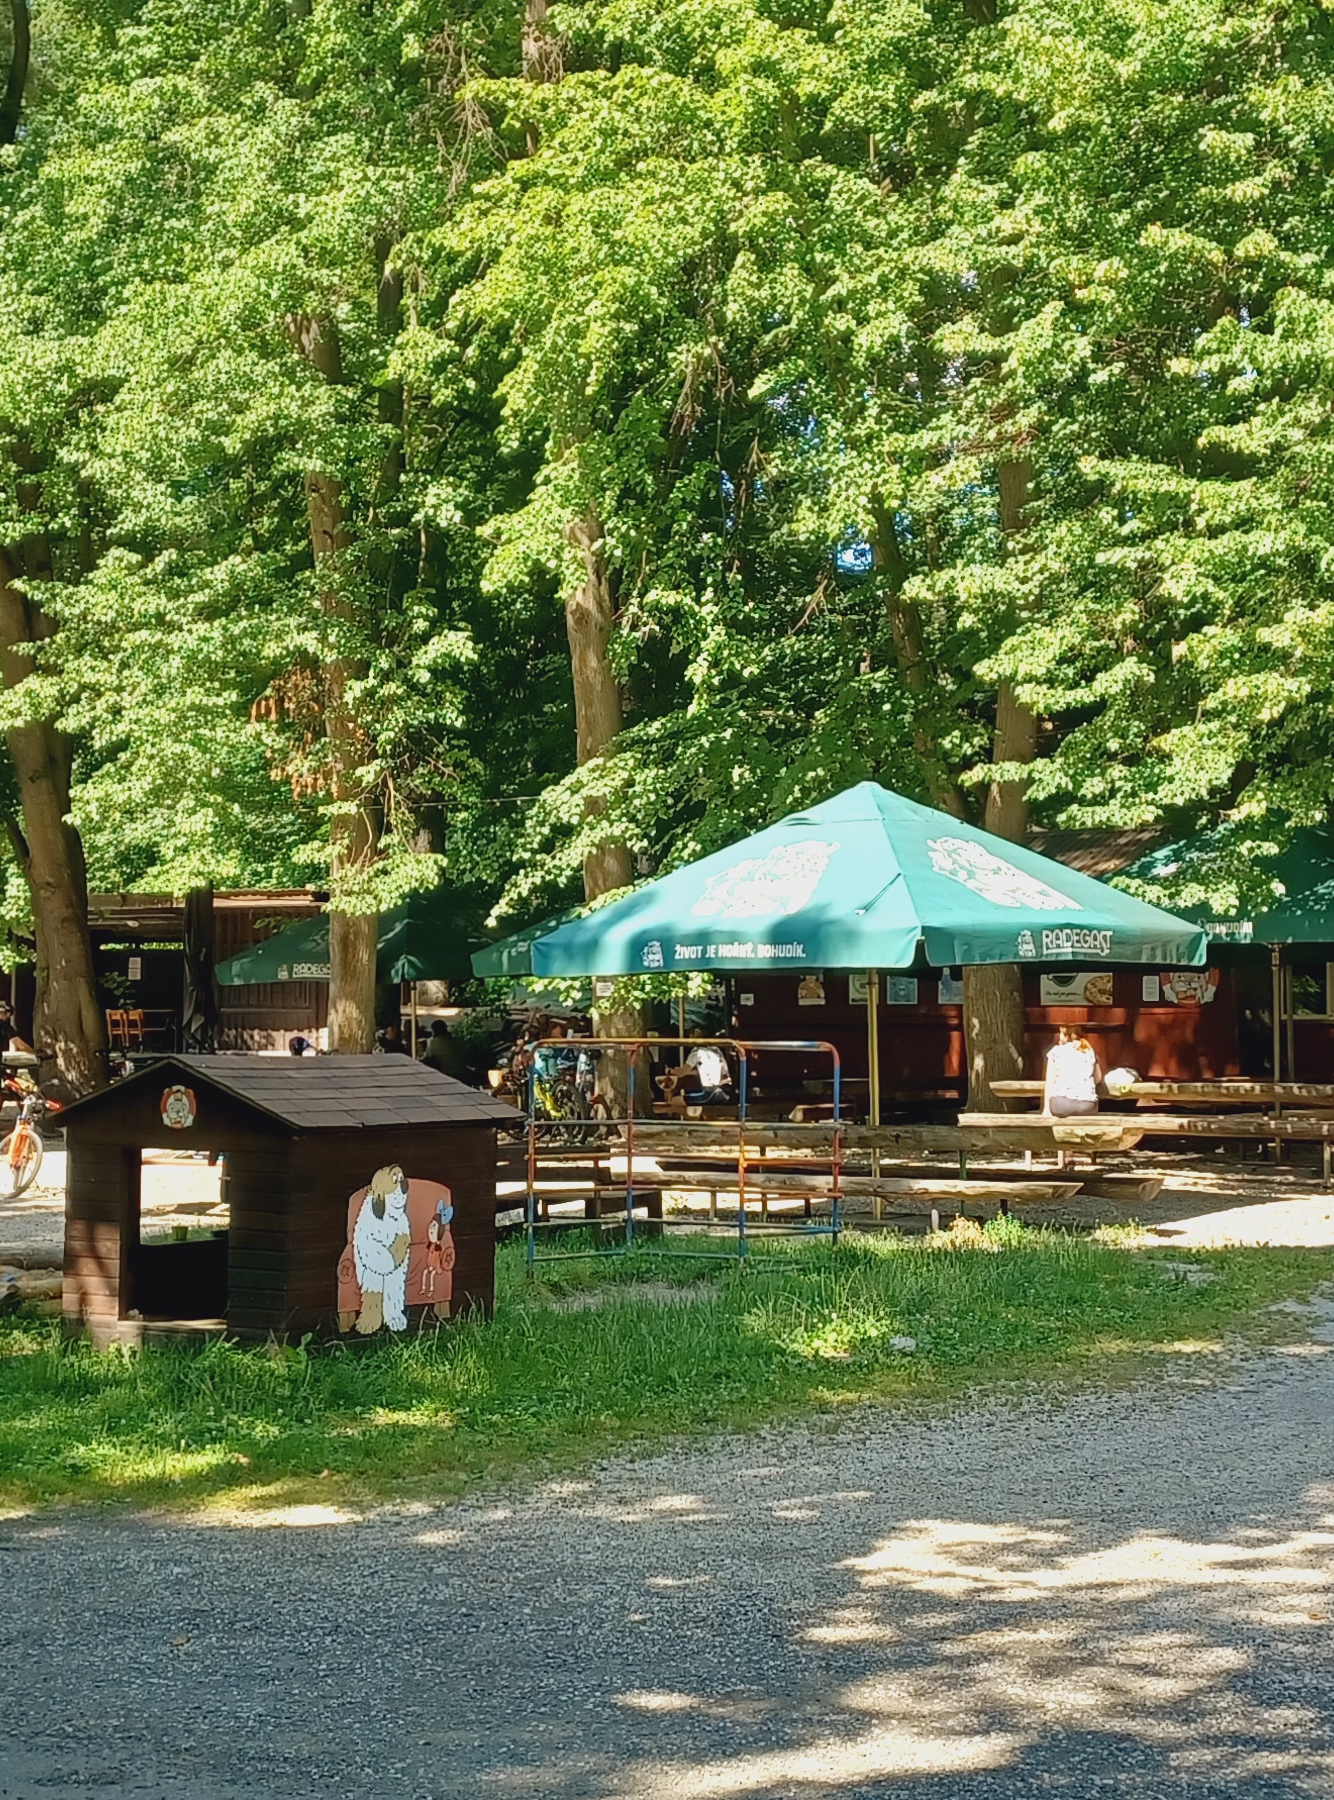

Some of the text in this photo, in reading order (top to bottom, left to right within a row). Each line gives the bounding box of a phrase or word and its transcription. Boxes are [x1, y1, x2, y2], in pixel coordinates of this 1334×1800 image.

[674, 944, 703, 959] ŽIVOT
[705, 945, 716, 958] JE
[757, 942, 806, 958] BOHUDÍK.
[1042, 928, 1113, 956] RADEGAST
[293, 963, 331, 978] RADEGA
